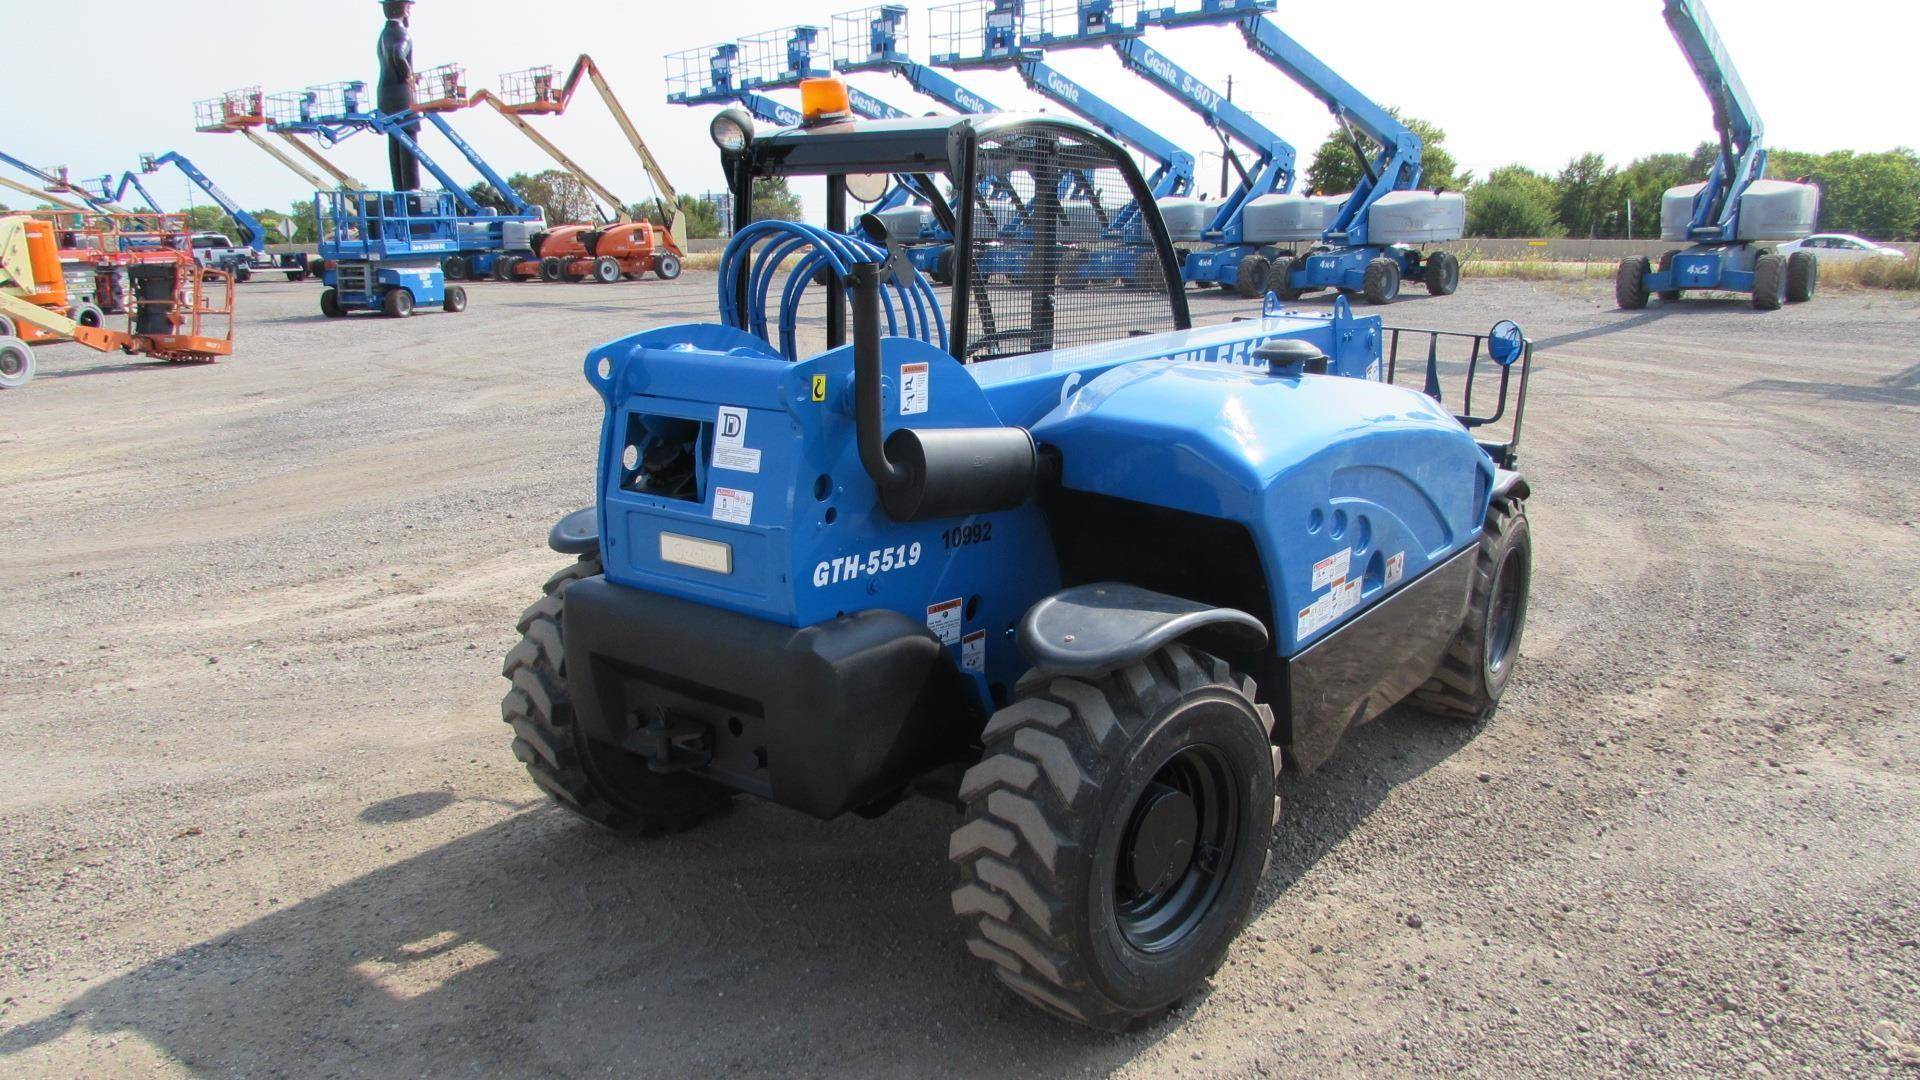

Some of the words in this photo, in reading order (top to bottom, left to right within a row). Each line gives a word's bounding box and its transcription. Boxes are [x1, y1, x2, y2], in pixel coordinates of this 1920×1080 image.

[1144, 49, 1177, 85] Genie
[955, 87, 985, 115] Genie
[1047, 71, 1080, 104] Genie
[774, 104, 803, 127] Geni
[848, 89, 882, 116] Genie
[1198, 258, 1213, 268] 4x4
[1319, 259, 1336, 270] 4x4
[1686, 264, 1710, 275] 4x2
[942, 521, 992, 550] 10992
[813, 541, 922, 588] GTH-5519
